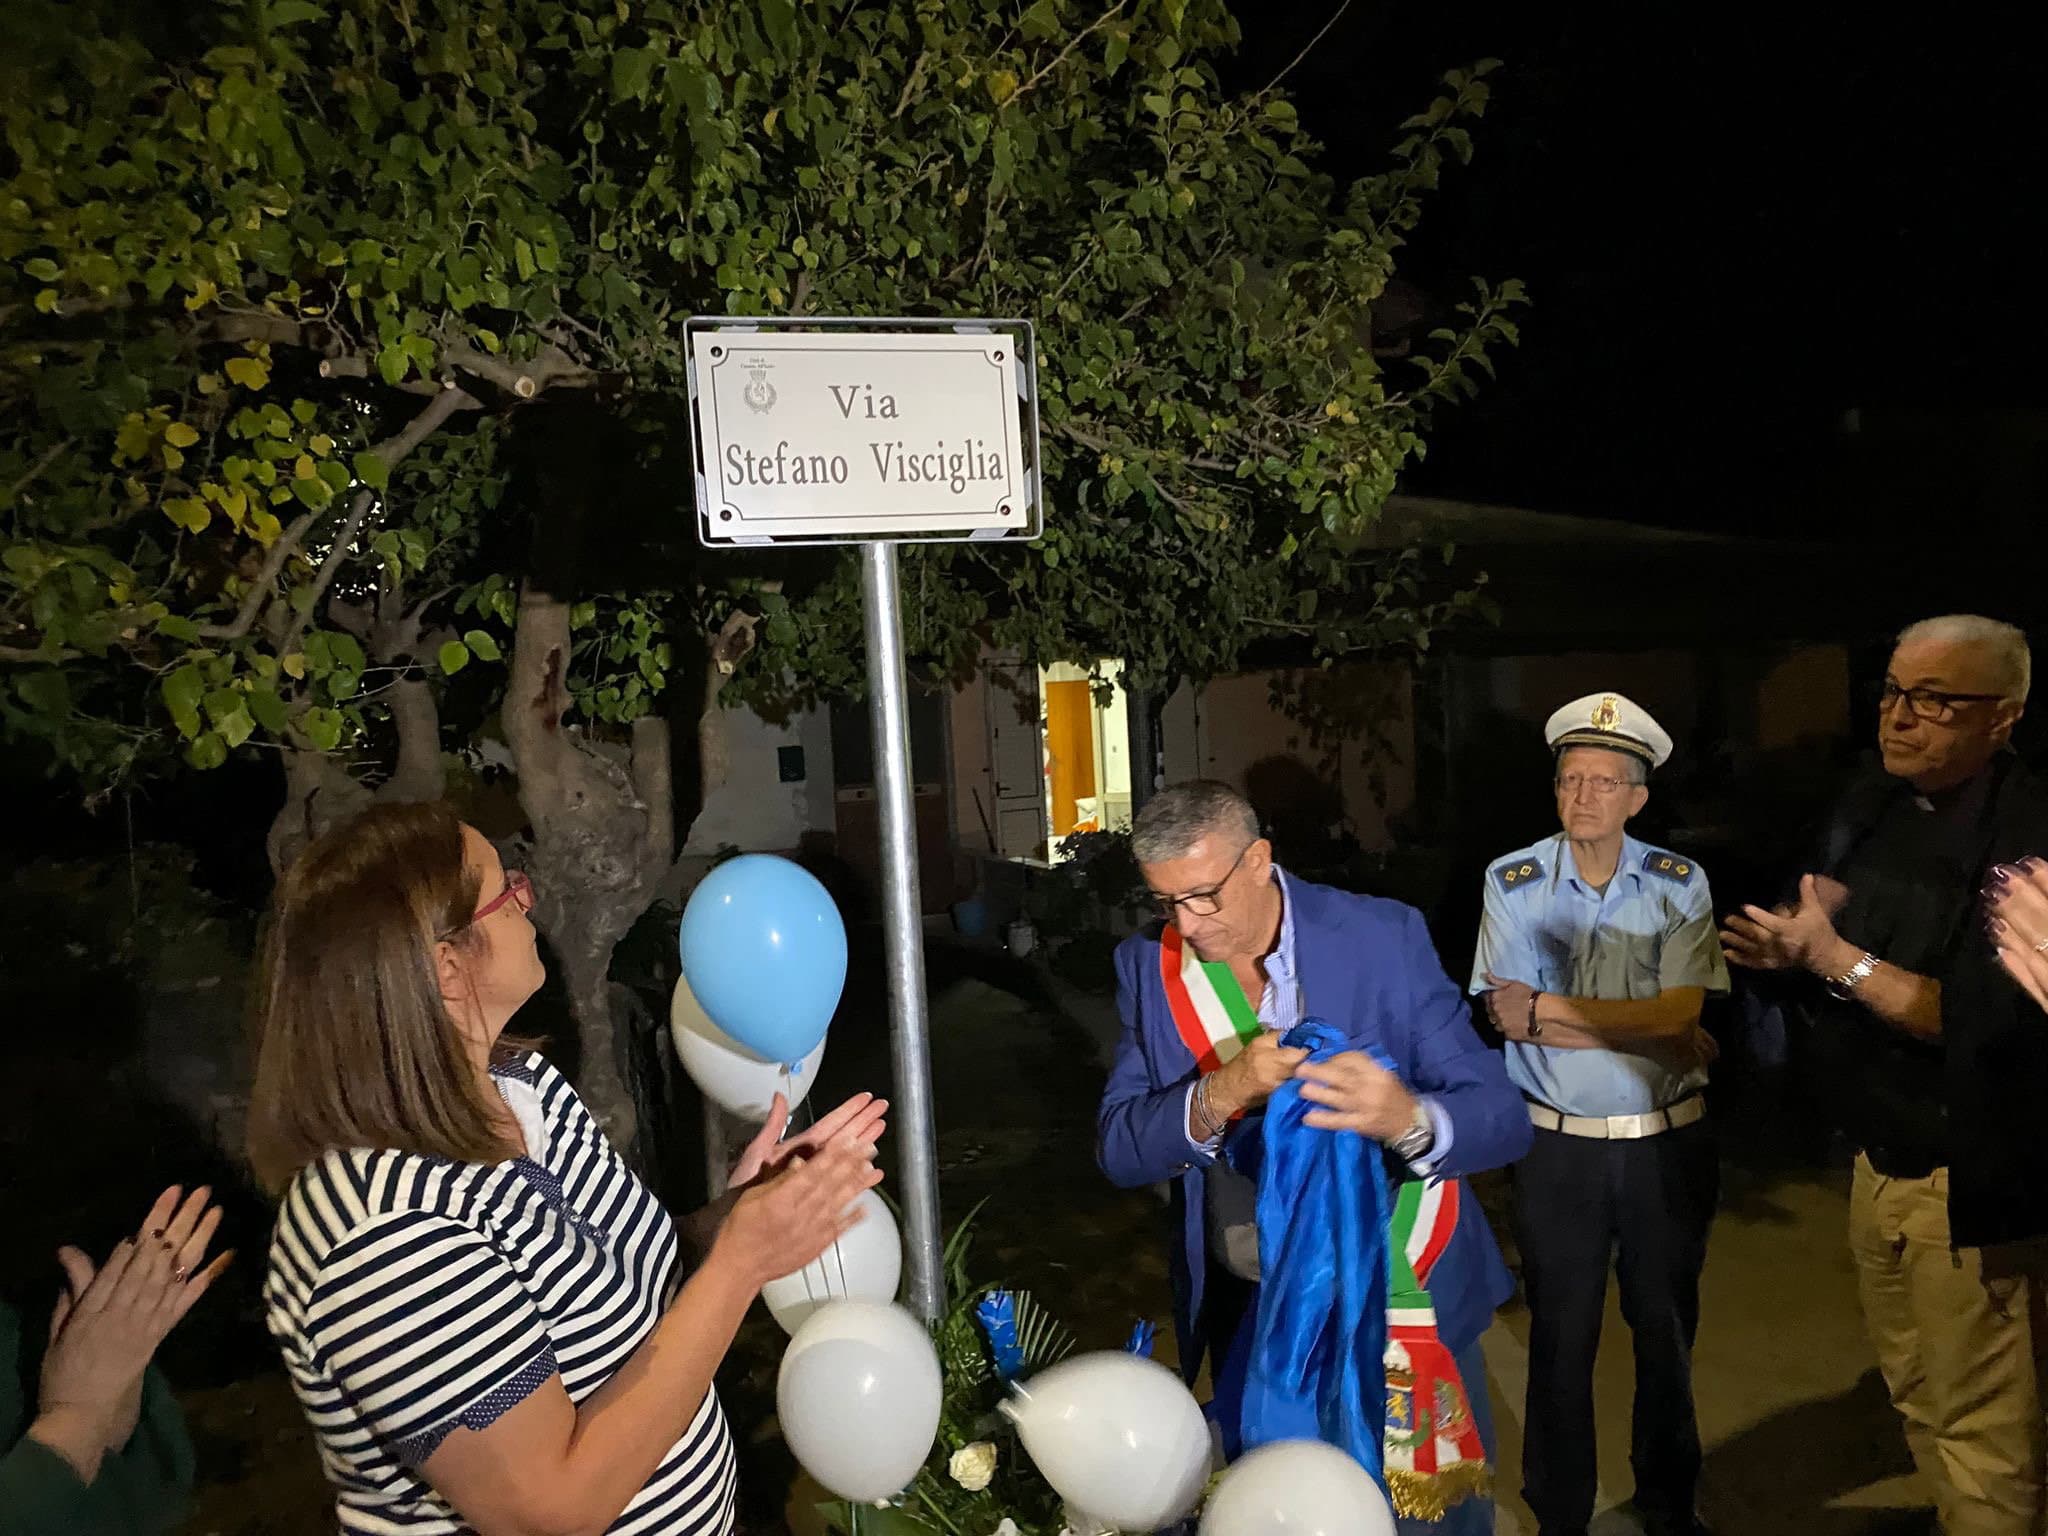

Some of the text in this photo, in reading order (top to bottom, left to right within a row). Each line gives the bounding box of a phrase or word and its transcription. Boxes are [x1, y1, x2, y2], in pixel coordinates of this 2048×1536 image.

[828, 384, 899, 419] Via
[726, 439, 1004, 494] Stefano Visciglia
